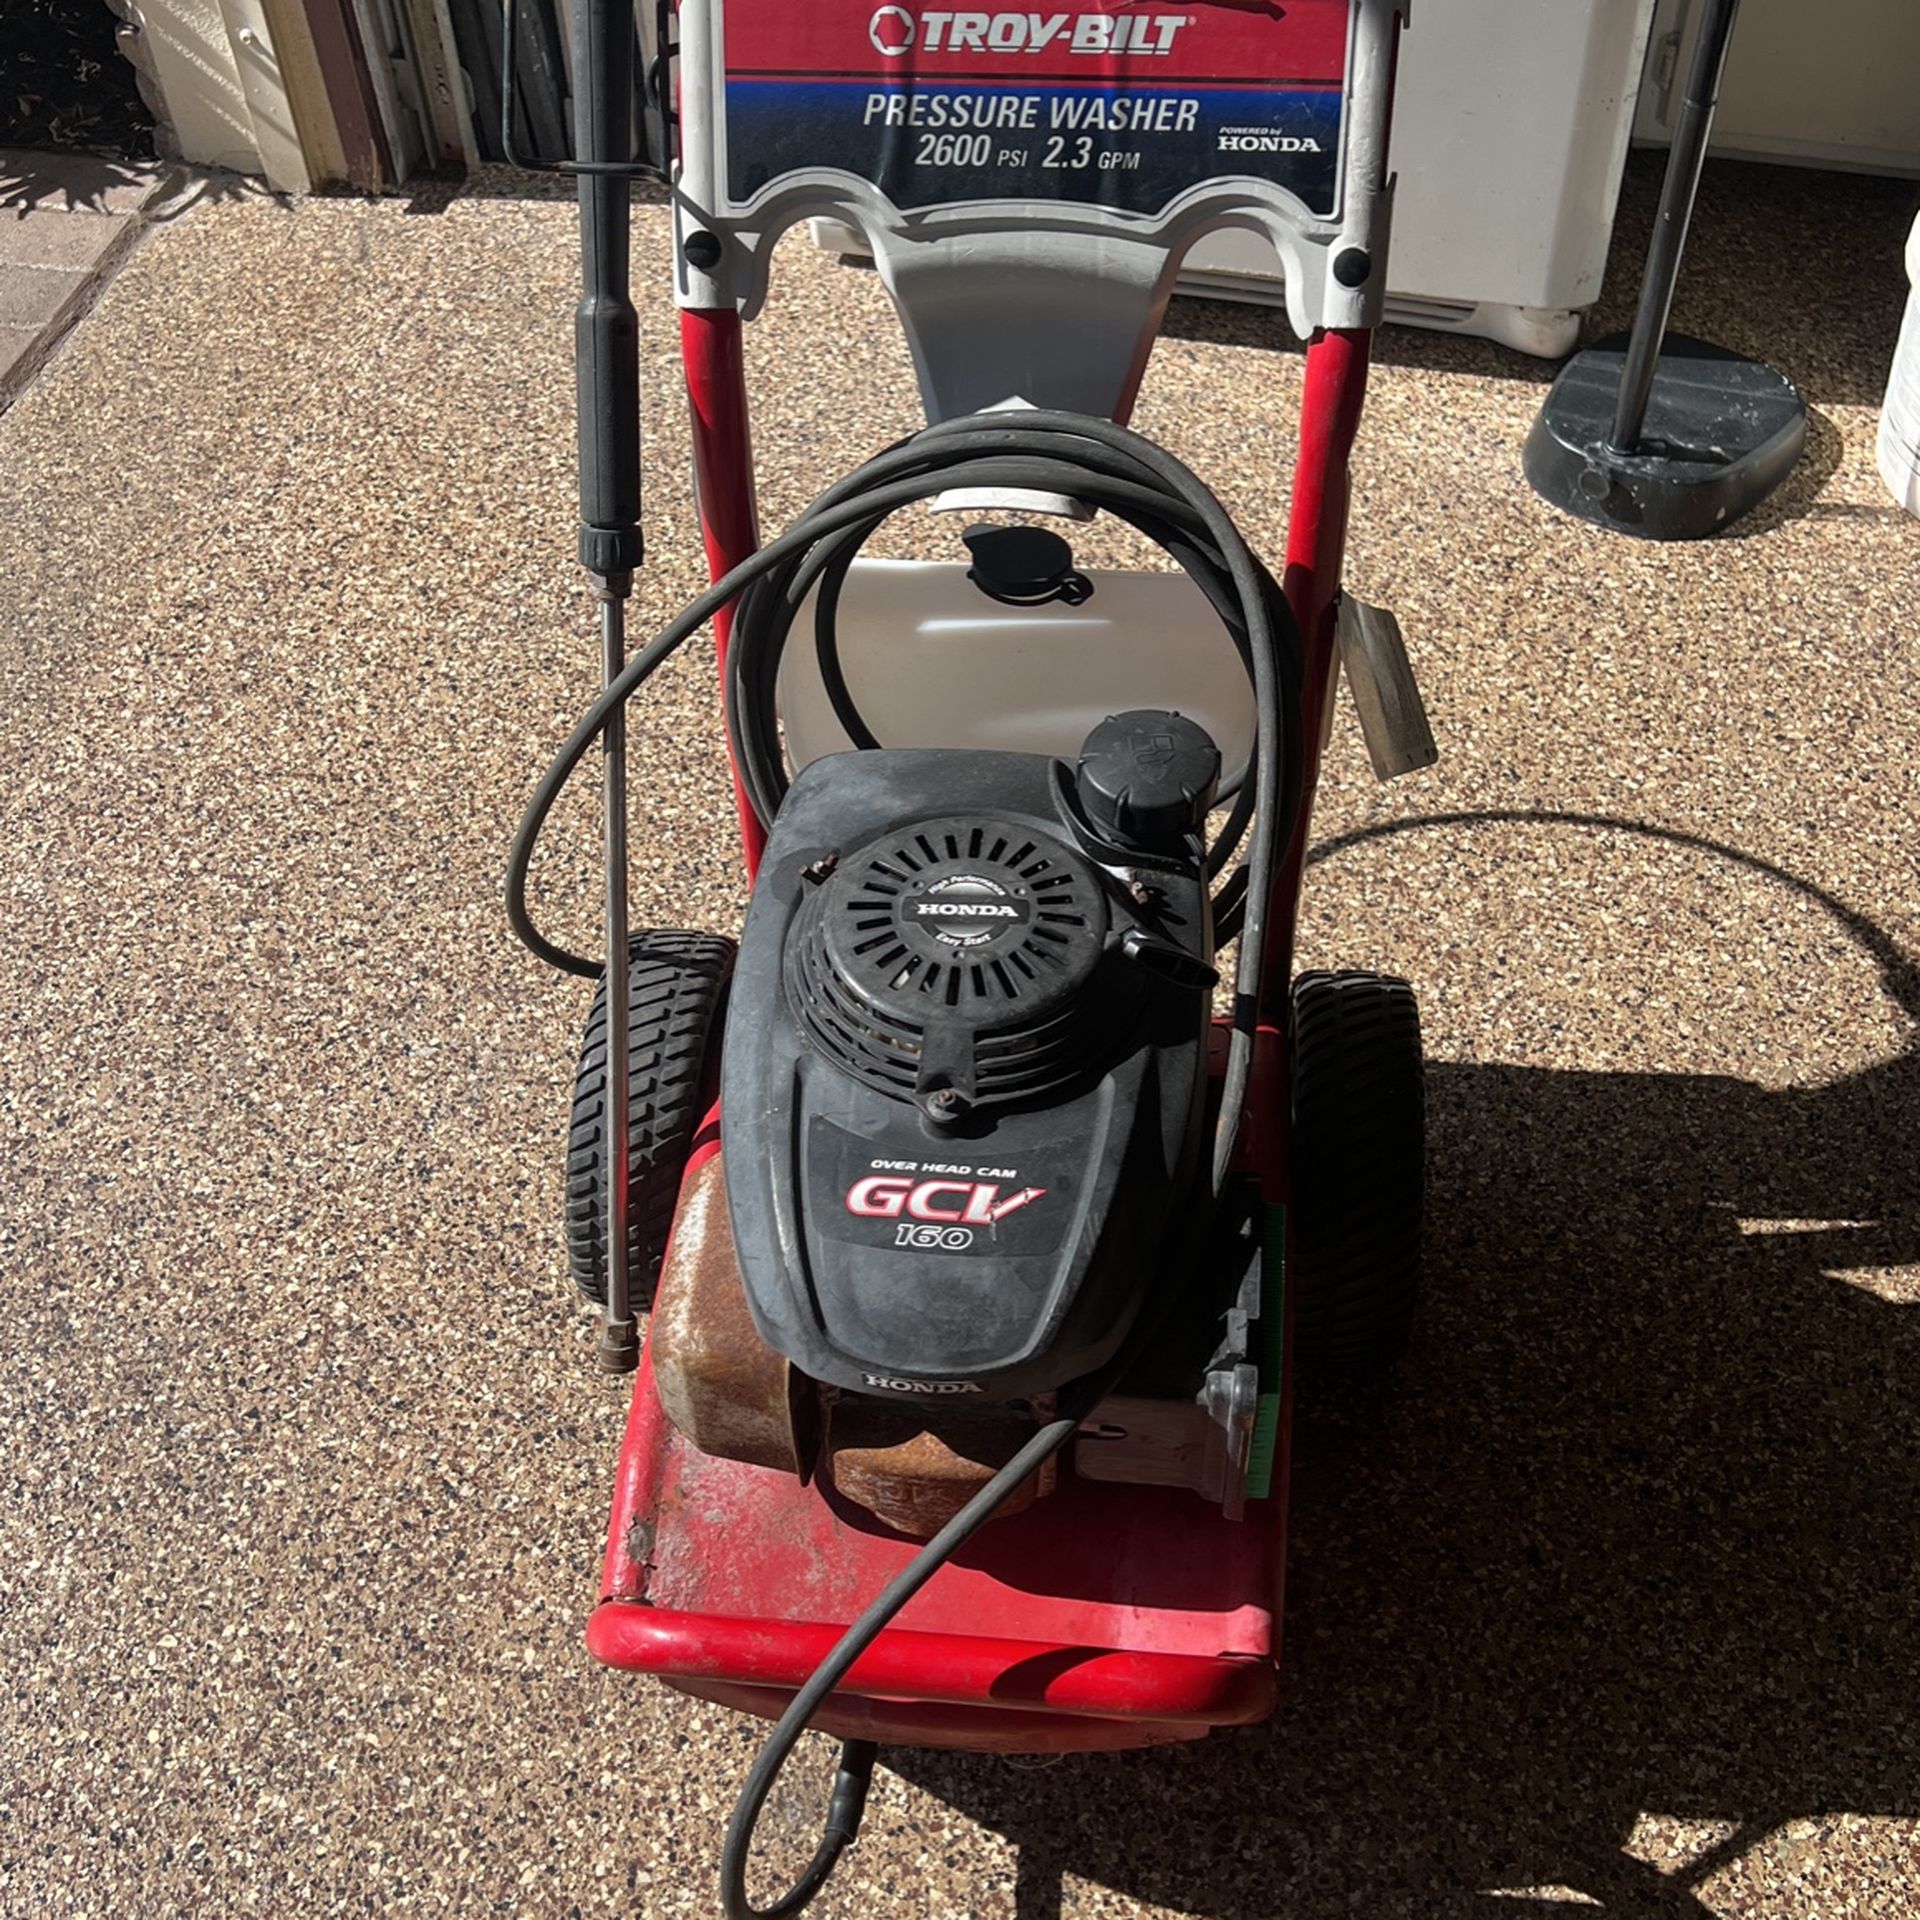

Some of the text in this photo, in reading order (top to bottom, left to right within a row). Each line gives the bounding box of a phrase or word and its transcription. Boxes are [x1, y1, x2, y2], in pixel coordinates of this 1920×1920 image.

[921, 12, 1187, 55] TROY-BILT
[863, 93, 1200, 132] PRESSURE WASHER
[1219, 126, 1282, 137] POWERED by
[914, 133, 1141, 170] 2600 PSI 2.3 GPM
[1217, 135, 1321, 152] HONDA
[928, 875, 1006, 896] High Performance
[917, 903, 1019, 917] HONDA
[935, 932, 992, 947] Easy Start
[870, 1159, 1017, 1179] OVER HEAD CAM
[846, 1175, 1047, 1225] GCV
[894, 1223, 974, 1250] 160
[865, 1374, 984, 1394] HONDA
